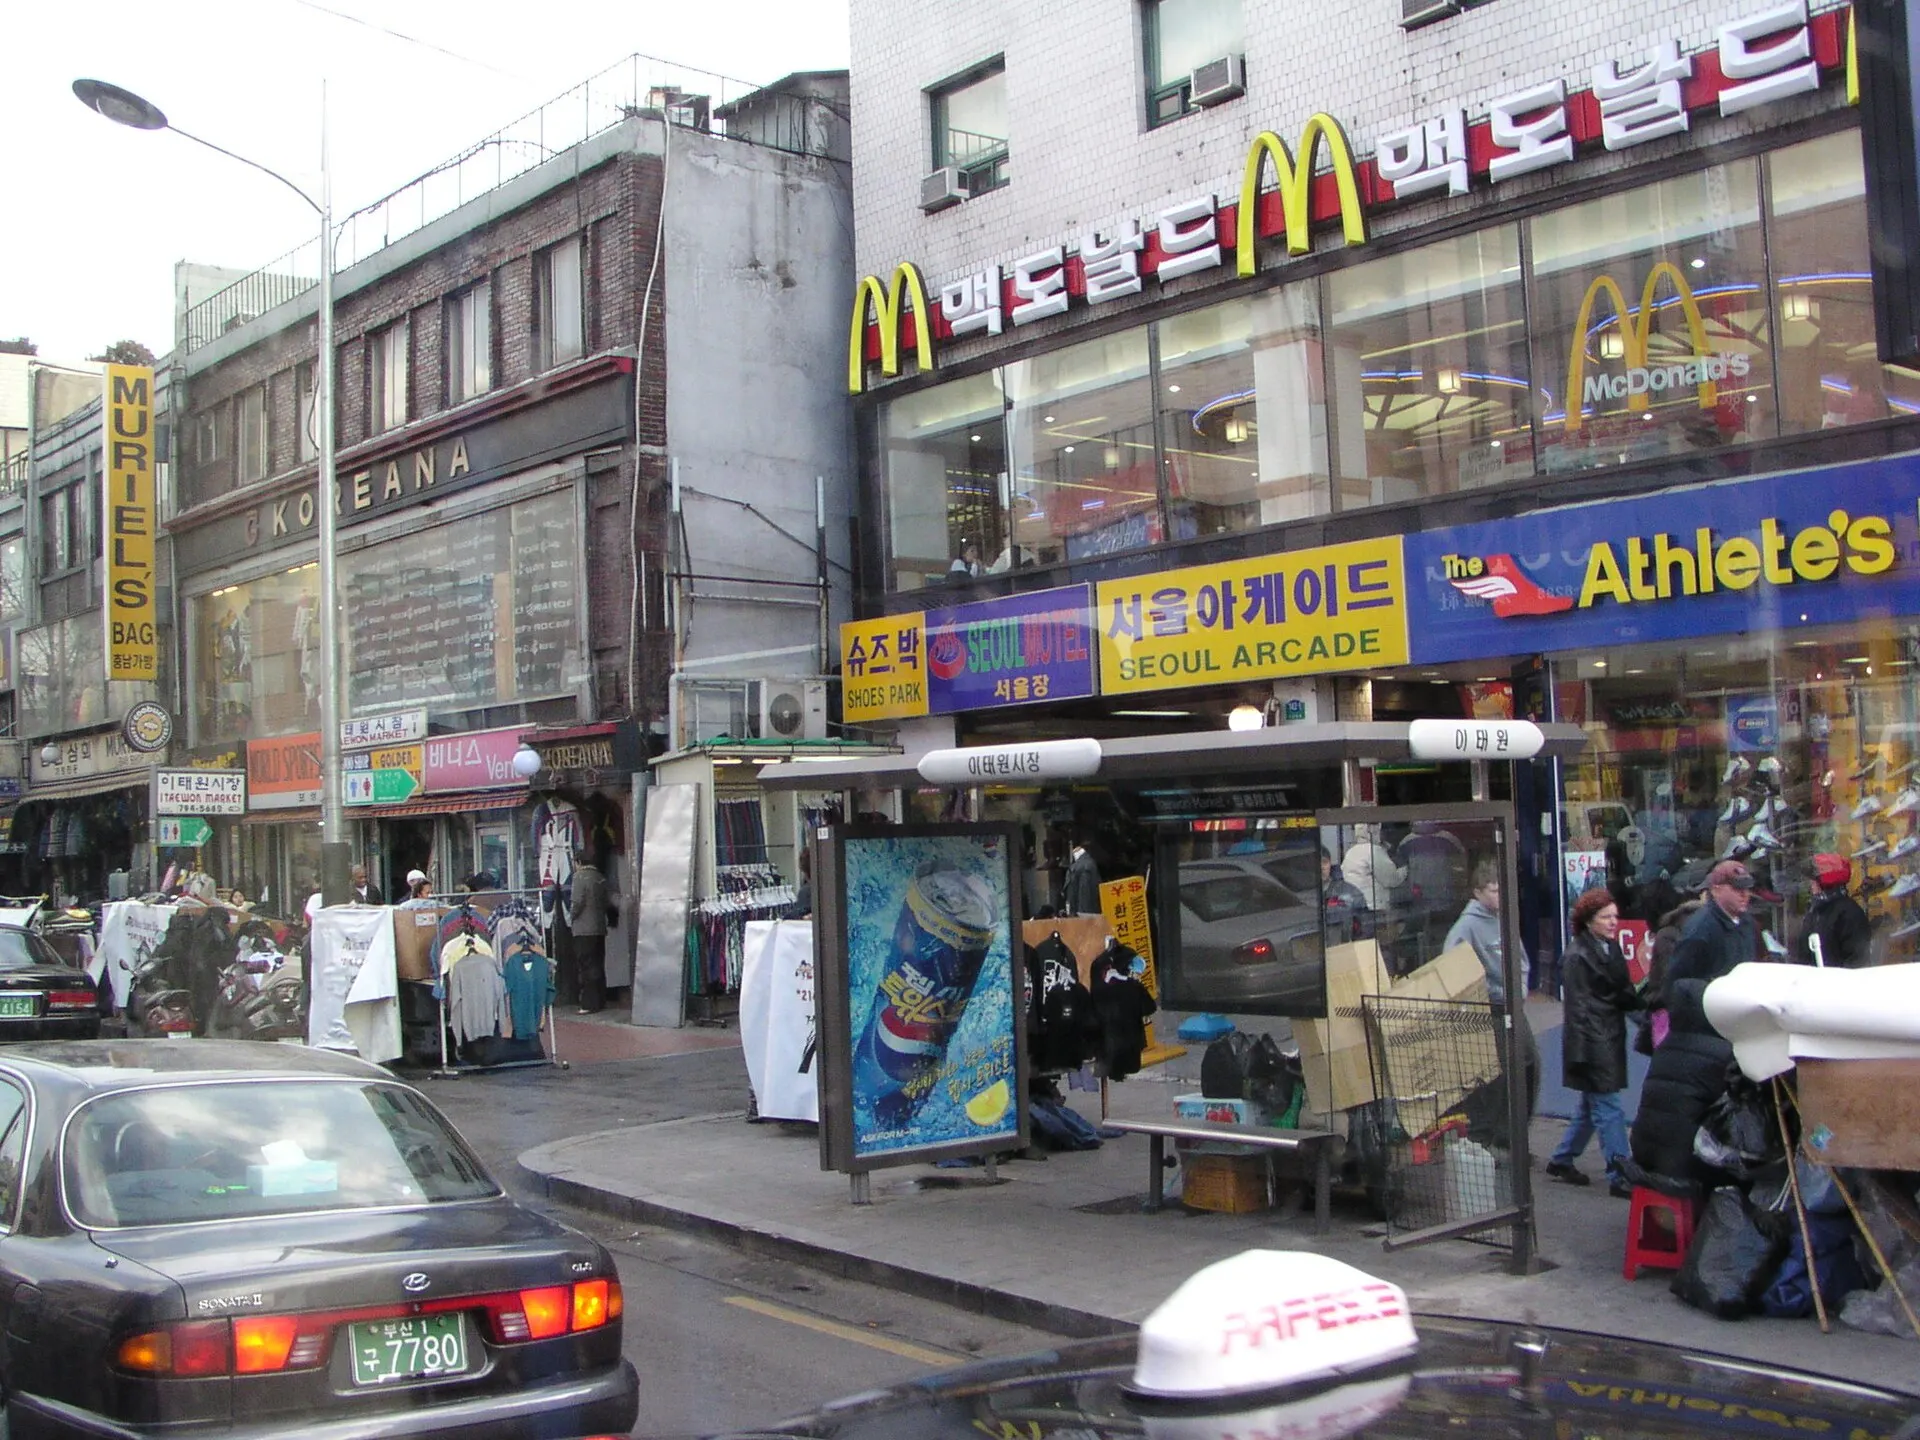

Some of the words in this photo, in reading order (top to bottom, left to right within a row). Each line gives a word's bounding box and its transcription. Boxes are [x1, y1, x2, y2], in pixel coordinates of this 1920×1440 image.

[1377, 2, 1818, 198] 맥도날드
[941, 194, 1221, 337] 맥도날드
[1583, 352, 1749, 403] McDonald's
[1441, 554, 1484, 579] The
[1578, 509, 1896, 608] Athlete's
[1106, 559, 1394, 643] 서울아케이드
[113, 621, 154, 645] BAG
[967, 617, 1024, 673] SEOUL
[1024, 608, 1087, 667] MOTEL
[1119, 649, 1220, 682] SEOUL
[1232, 628, 1381, 669] ARCADE
[847, 687, 885, 709] SHOES
[890, 682, 921, 704] PARK
[994, 674, 1050, 701] 서울장
[429, 738, 482, 769] 비너스
[1455, 728, 1509, 752] 이태원
[380, 750, 413, 768] GOLDEN
[968, 752, 1040, 776] 이태원시장
[161, 776, 240, 791] 이태원시장
[160, 793, 202, 804] ITAEWON
[205, 793, 242, 803] MARKET
[199, 1296, 251, 1310] SONATA
[384, 1321, 412, 1339] 부산
[421, 1320, 428, 1334] 1
[363, 1348, 381, 1372] 구
[385, 1333, 459, 1374] 7780
